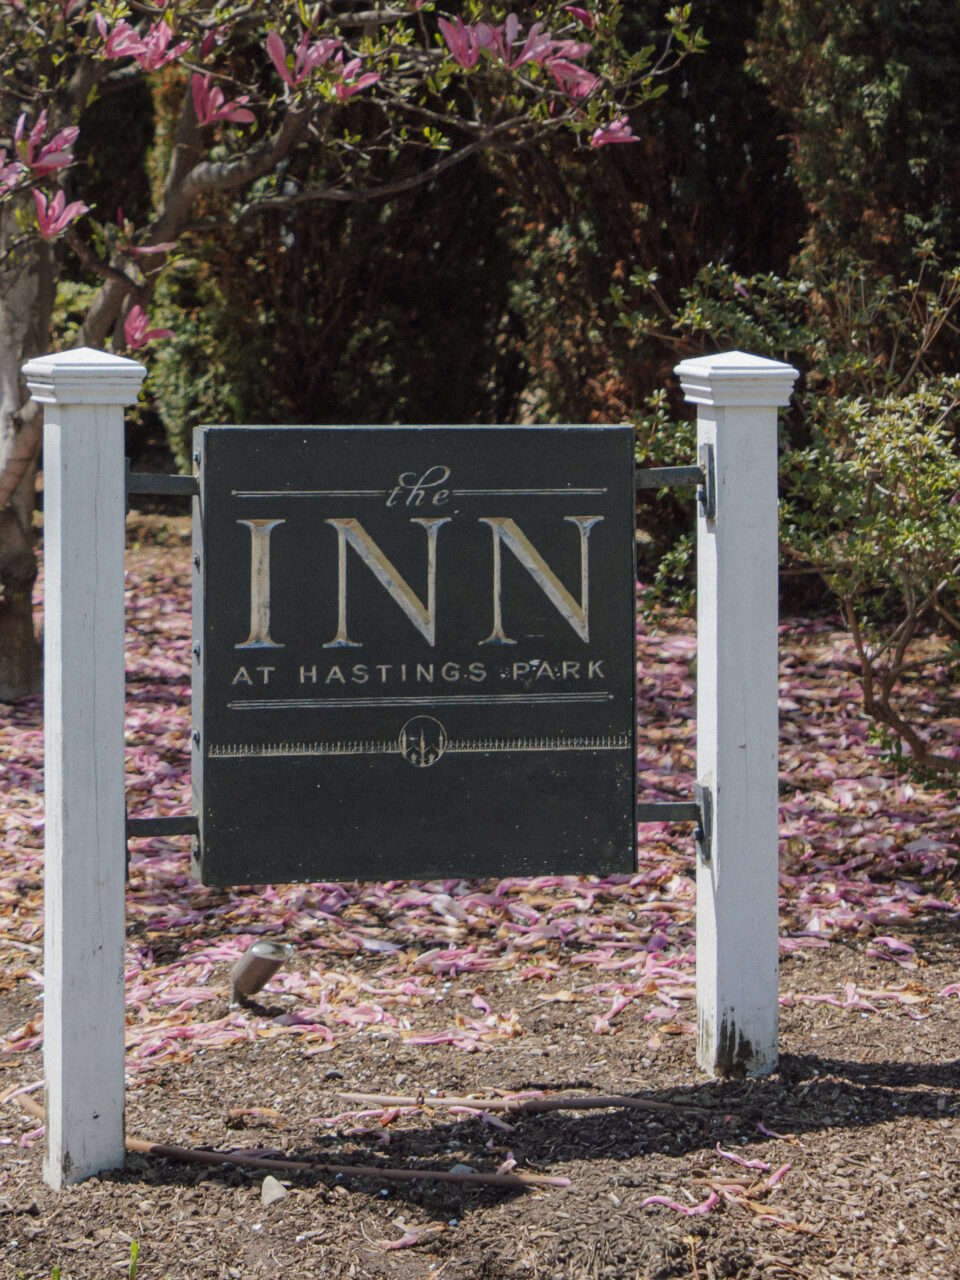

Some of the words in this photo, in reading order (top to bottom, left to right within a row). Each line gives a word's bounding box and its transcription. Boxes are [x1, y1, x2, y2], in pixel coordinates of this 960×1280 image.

[385, 465, 451, 507] the
[233, 516, 605, 649] INN
[231, 666, 276, 685] AT
[299, 662, 487, 684] HASTINGS
[512, 659, 606, 680] PARK
